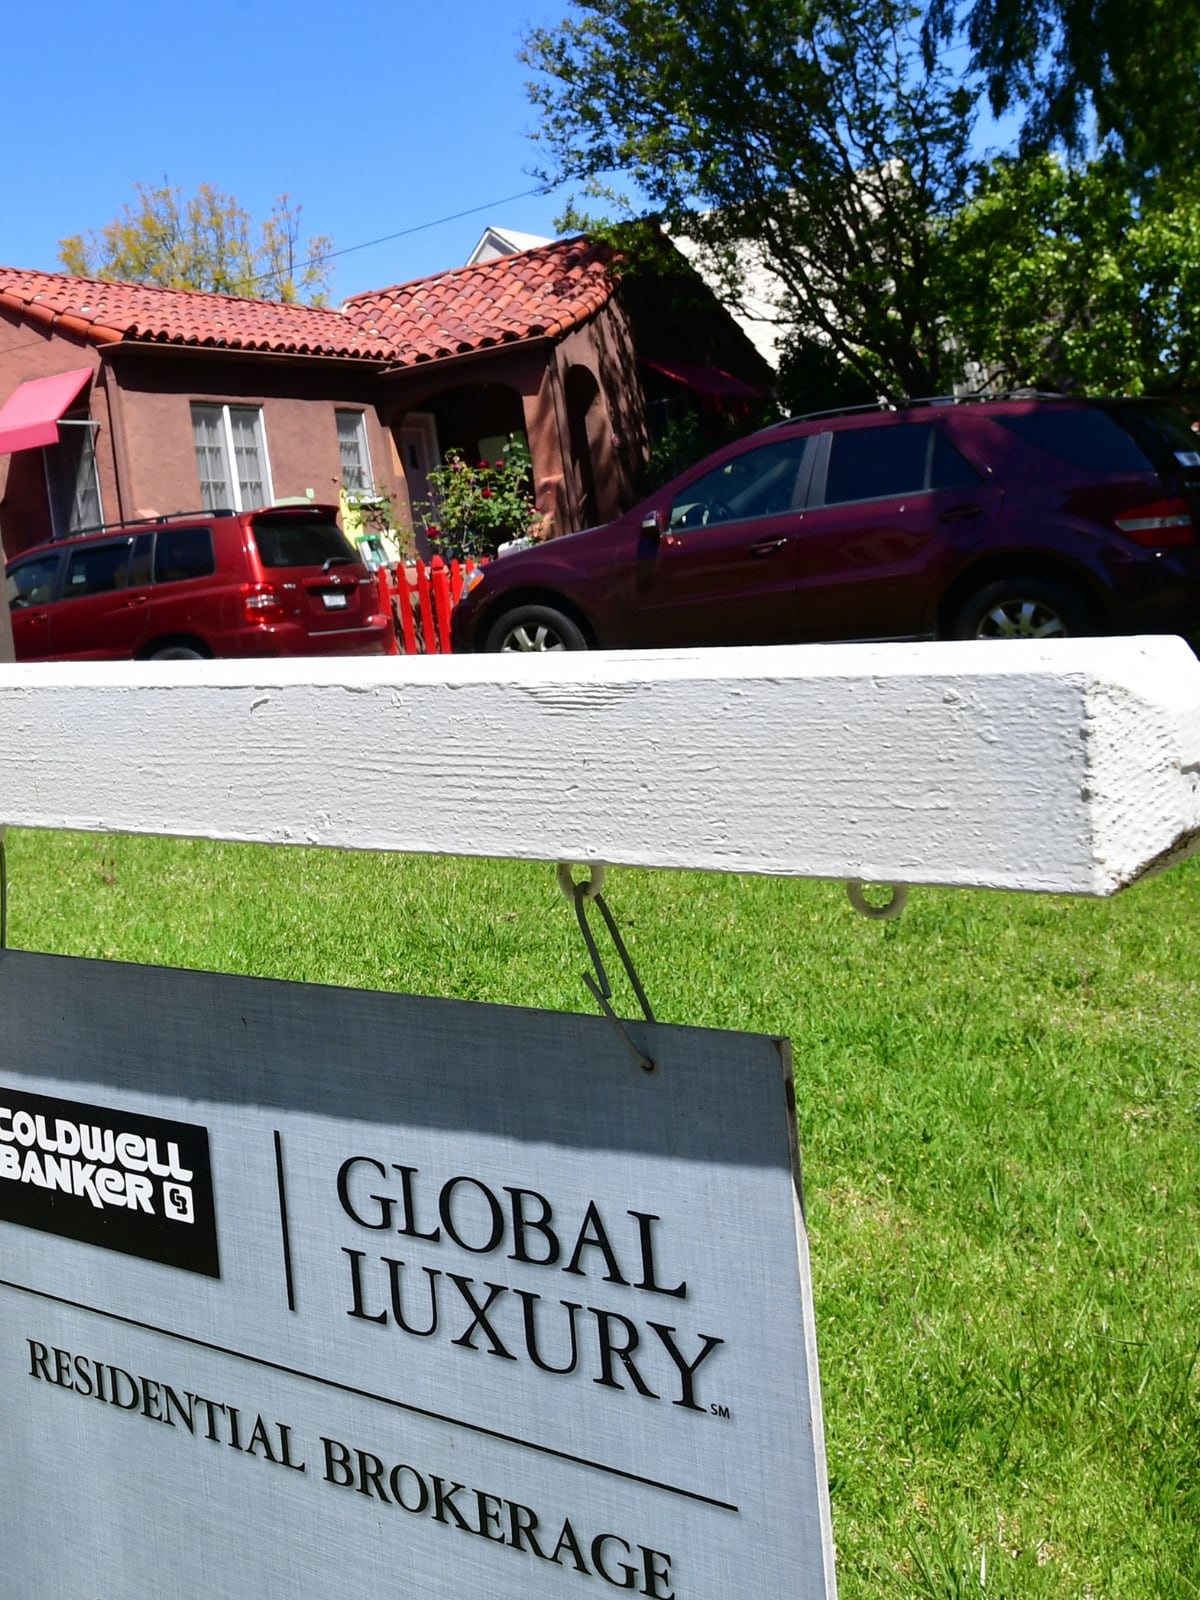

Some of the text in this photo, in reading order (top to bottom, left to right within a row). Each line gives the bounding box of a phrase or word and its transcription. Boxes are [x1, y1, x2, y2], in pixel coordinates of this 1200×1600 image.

[336, 1156, 687, 1300] GLOBAL
[340, 1246, 730, 1420] LUXURY SM
[25, 1338, 676, 1600] RESIDENTIAL BROKERAGE
